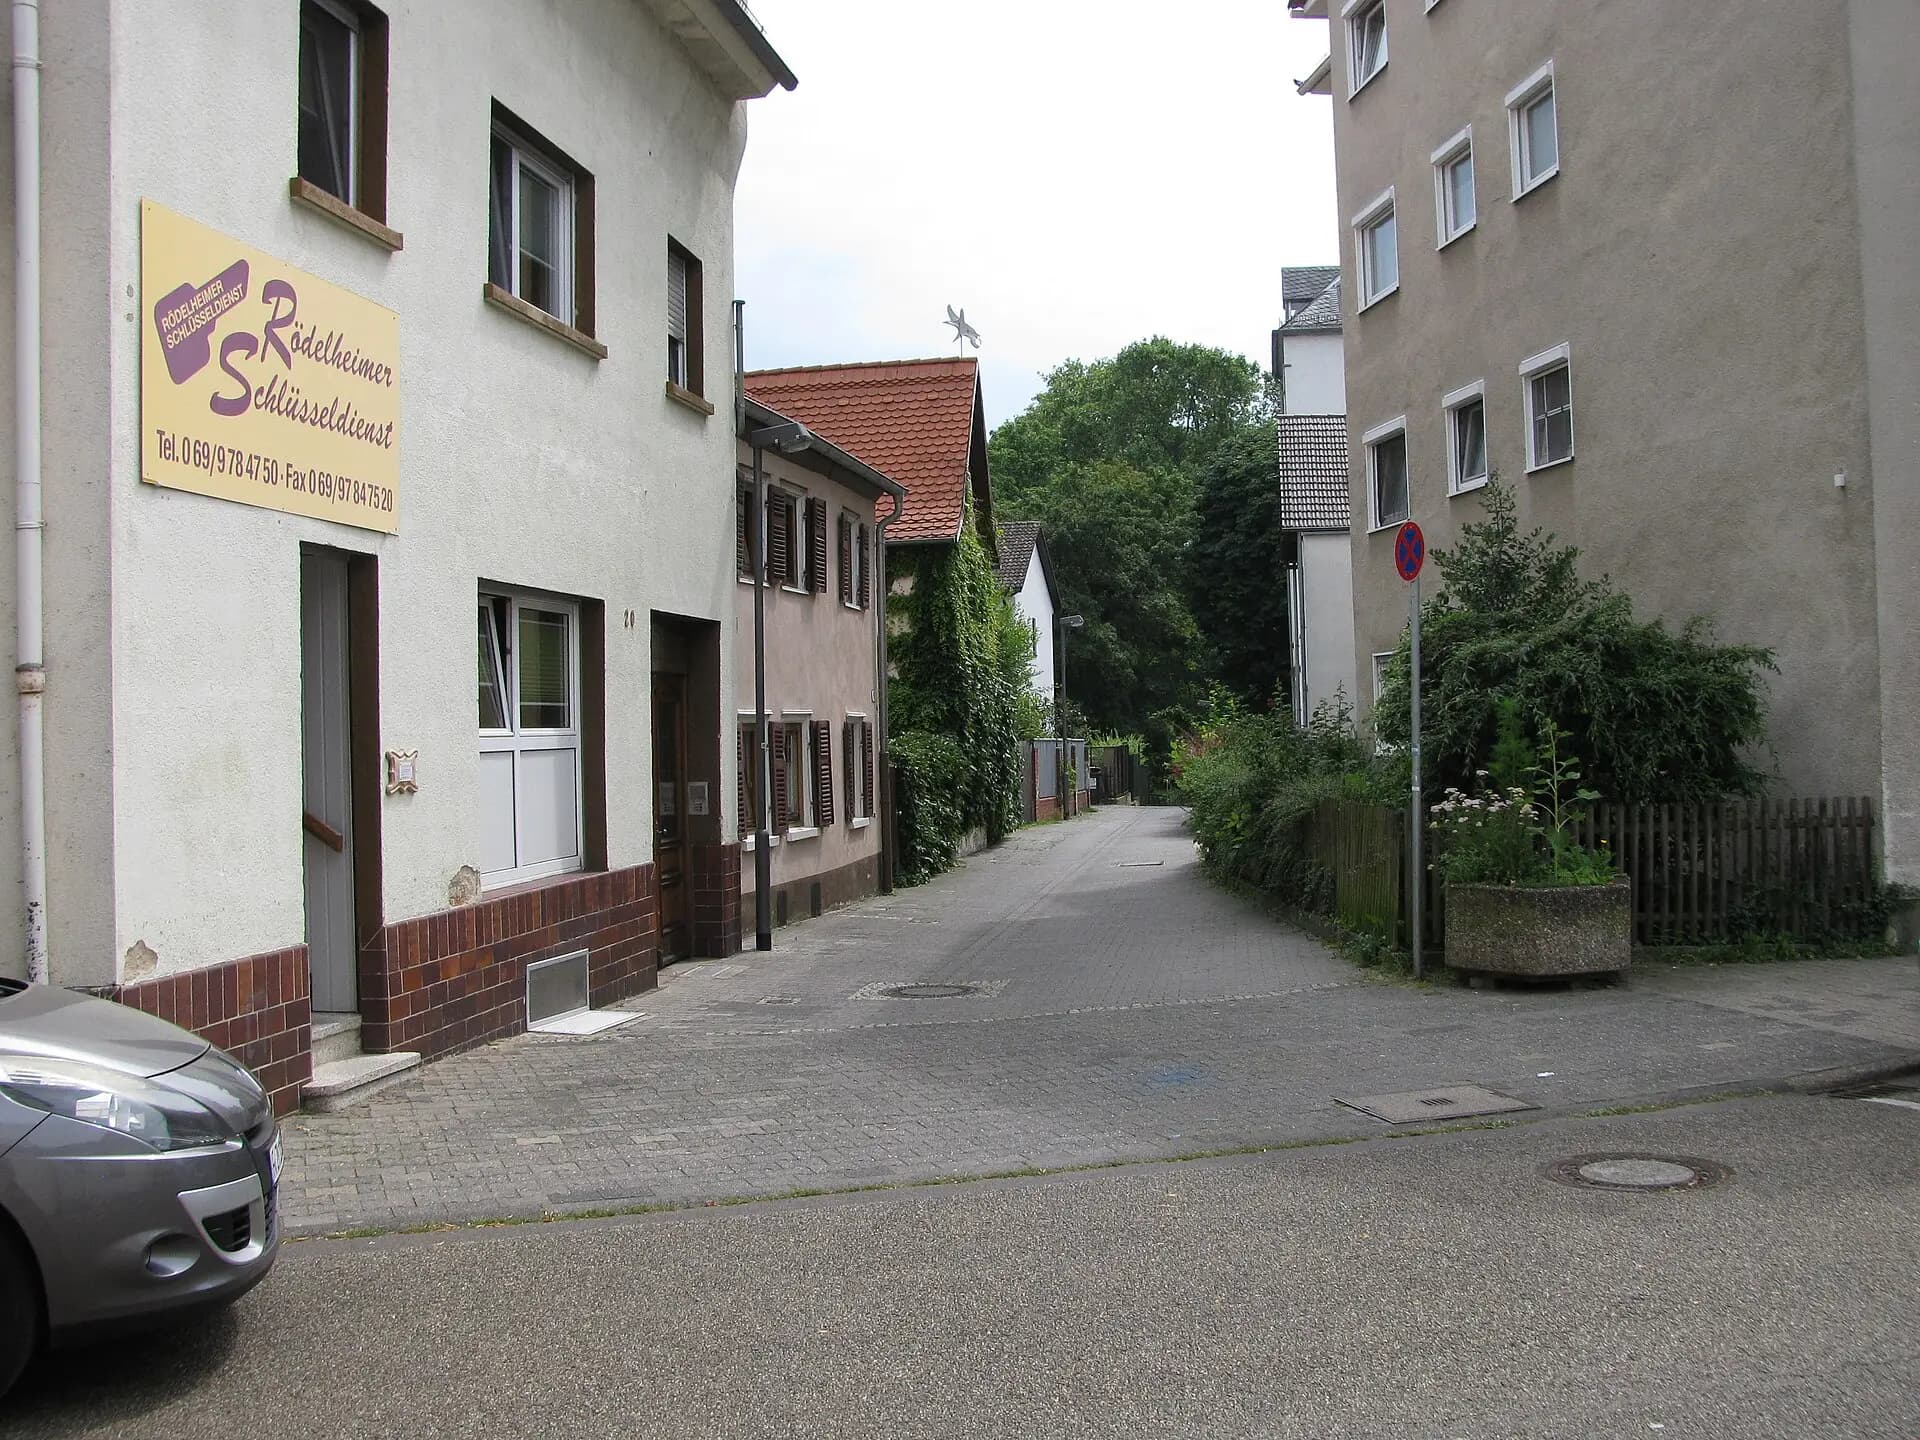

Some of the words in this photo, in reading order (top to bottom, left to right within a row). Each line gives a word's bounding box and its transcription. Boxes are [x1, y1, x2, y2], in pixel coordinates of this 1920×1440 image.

[161, 280, 224, 333] RÖDELHEIMER
[166, 283, 244, 349] SCHLÜSSELDIENST
[261, 279, 393, 388] Rödelheimer
[210, 332, 393, 450] Schlüsseldienst
[156, 429, 179, 463] Tel.
[286, 462, 306, 492] Fax
[624, 607, 635, 628] 20
